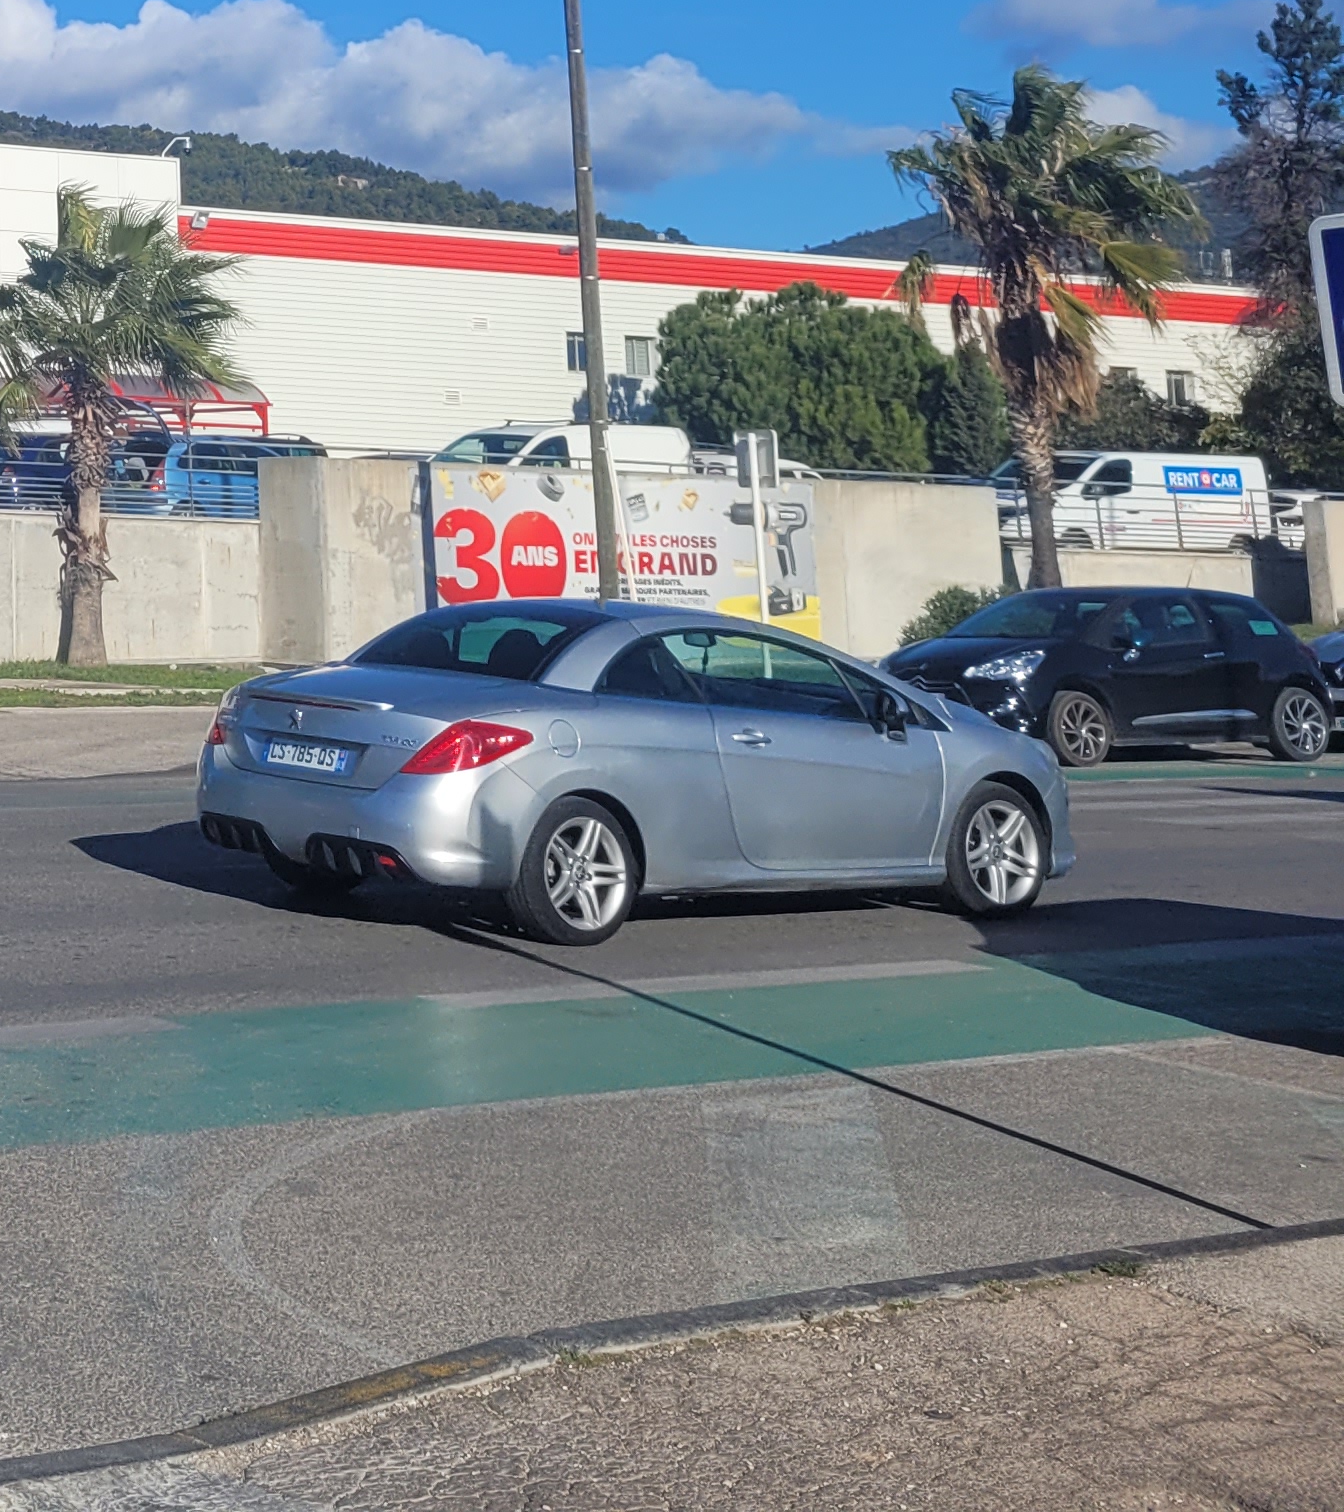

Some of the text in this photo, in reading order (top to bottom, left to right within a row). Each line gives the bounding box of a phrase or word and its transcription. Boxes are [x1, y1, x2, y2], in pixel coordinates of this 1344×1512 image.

[1168, 471, 1199, 487] RENT
[1212, 473, 1237, 488] CAR
[573, 532, 594, 546] ON
[632, 534, 657, 547] LES
[660, 535, 717, 549] CHOSES
[434, 508, 567, 603] 30
[511, 544, 558, 568] ANS
[617, 551, 717, 576] GRAND
